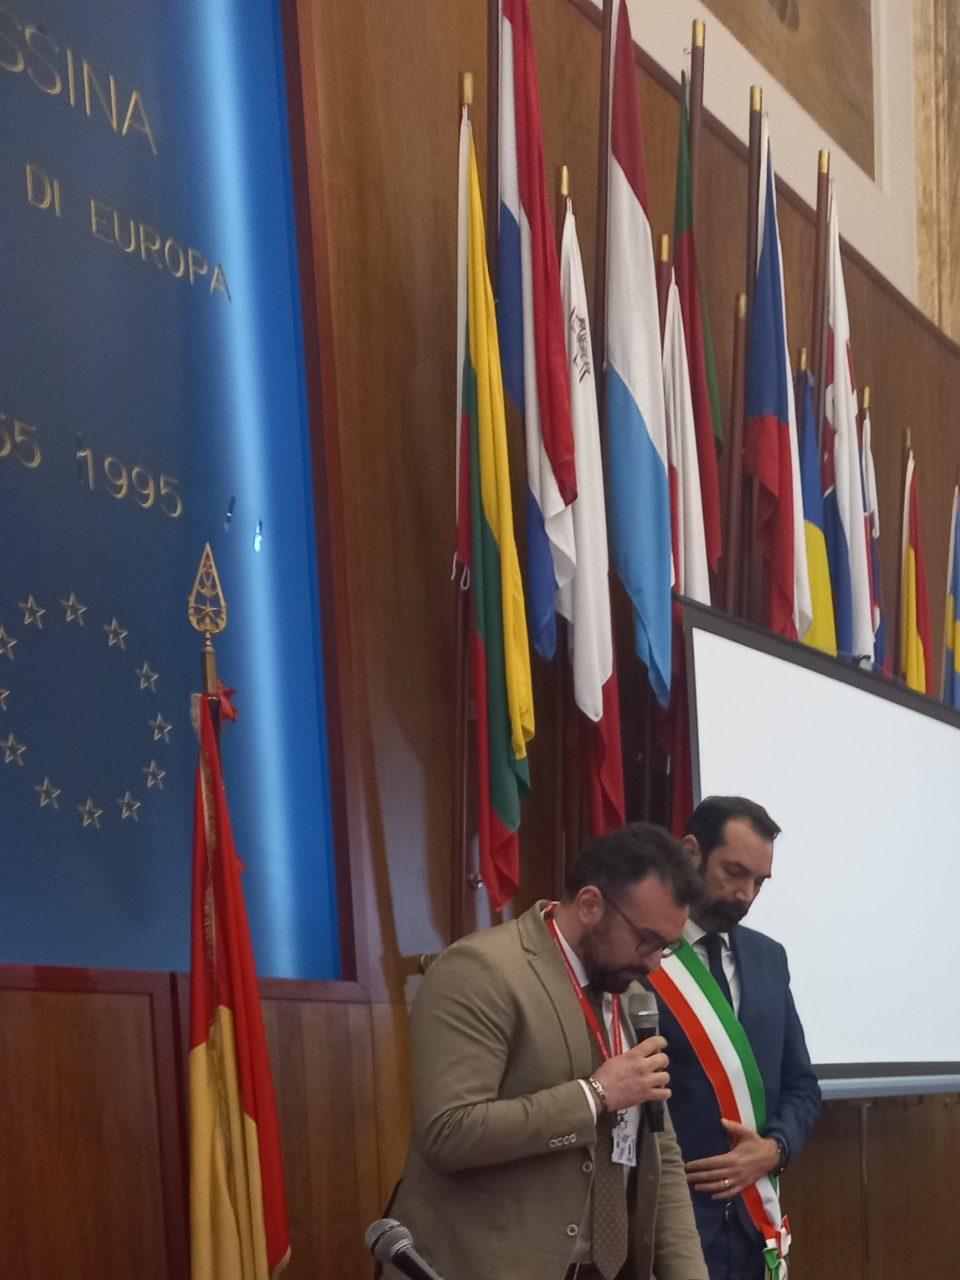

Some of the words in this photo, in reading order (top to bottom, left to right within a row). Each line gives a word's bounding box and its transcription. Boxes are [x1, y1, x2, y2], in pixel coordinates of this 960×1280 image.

[26, 164, 61, 218] DI
[91, 198, 231, 304] EUROPA
[75, 447, 183, 518] 1995
